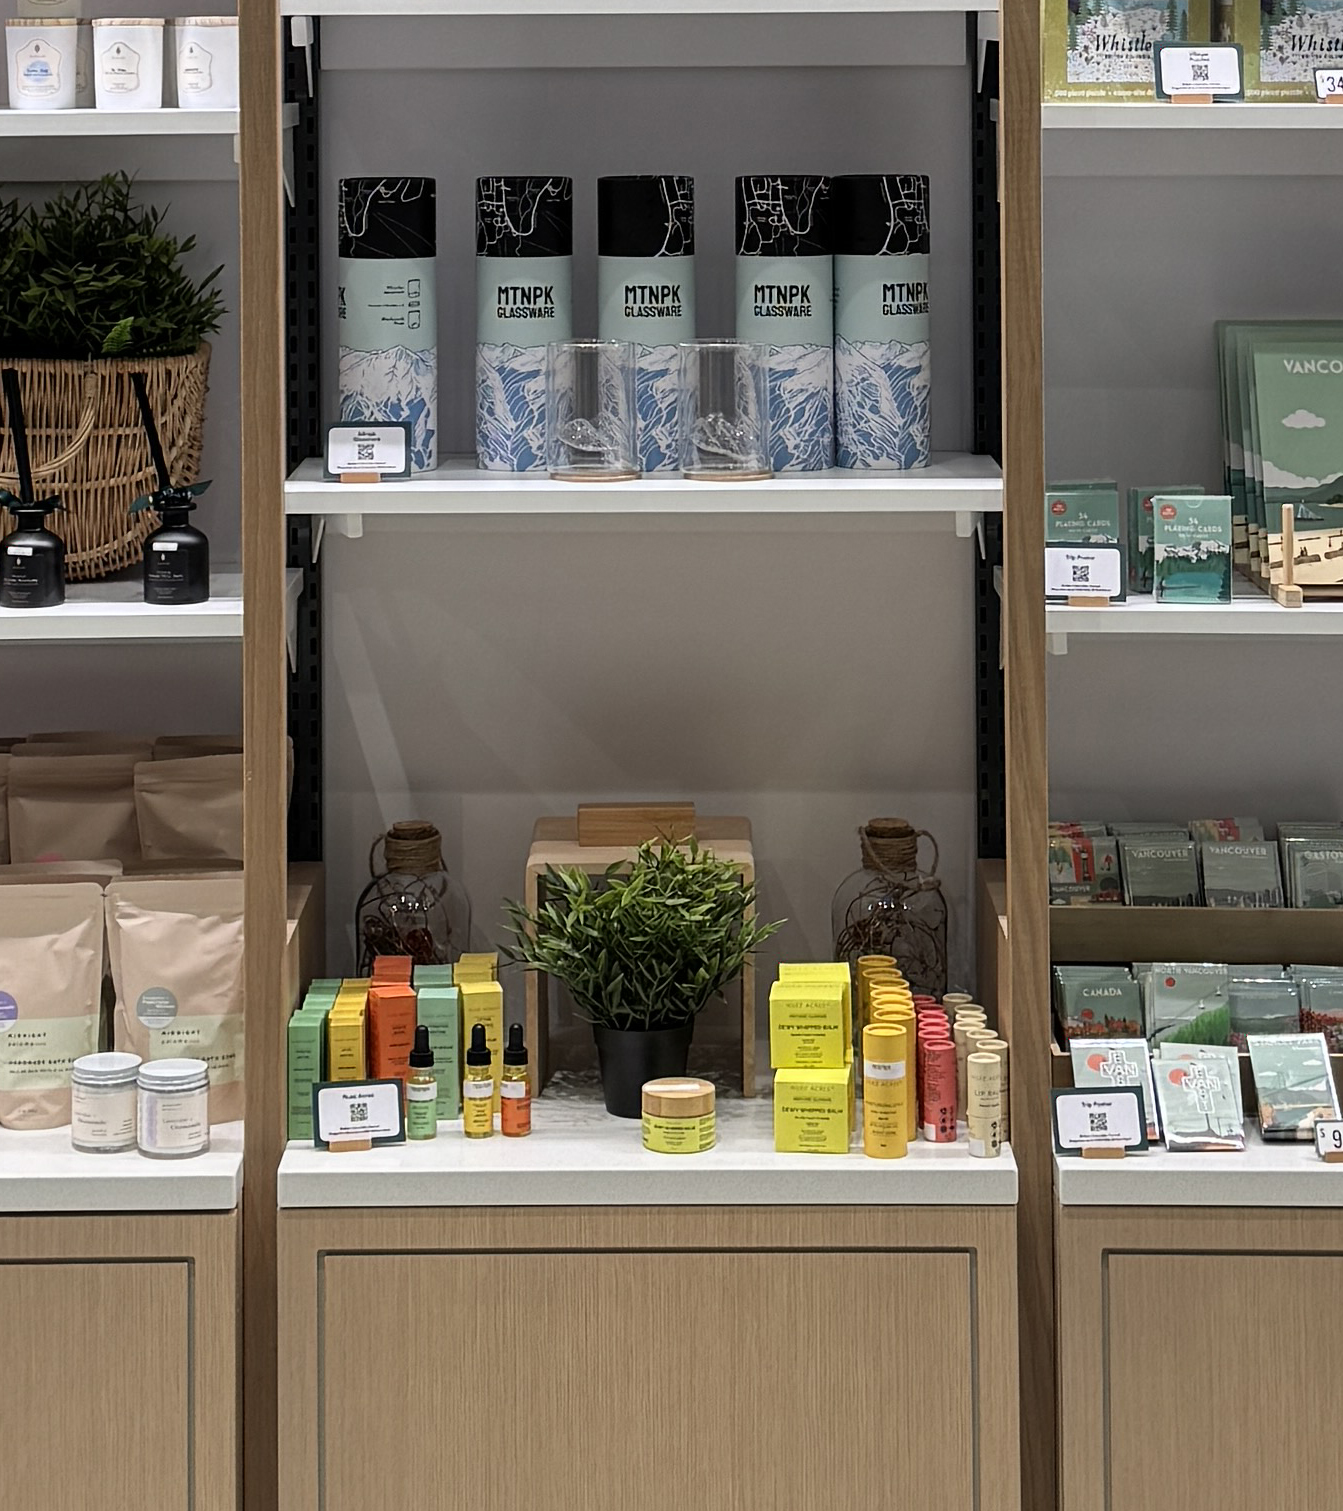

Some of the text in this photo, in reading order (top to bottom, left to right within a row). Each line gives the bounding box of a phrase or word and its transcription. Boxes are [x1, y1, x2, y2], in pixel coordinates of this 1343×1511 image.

[1096, 30, 1152, 52] Whistle
[497, 285, 555, 306] MTNPK
[624, 284, 682, 305] MTNPK
[754, 284, 811, 304] MTNPK
[882, 282, 929, 303] MTNPK
[497, 306, 555, 319] GLASSWARE
[624, 305, 683, 318] GLASSWARE
[754, 305, 812, 317] GLASSWARE
[882, 303, 930, 316] GLASSWARE
[1131, 848, 1189, 859] VANCOUVER
[1208, 846, 1268, 856] VANCOUVER
[1082, 987, 1123, 998] CANADA
